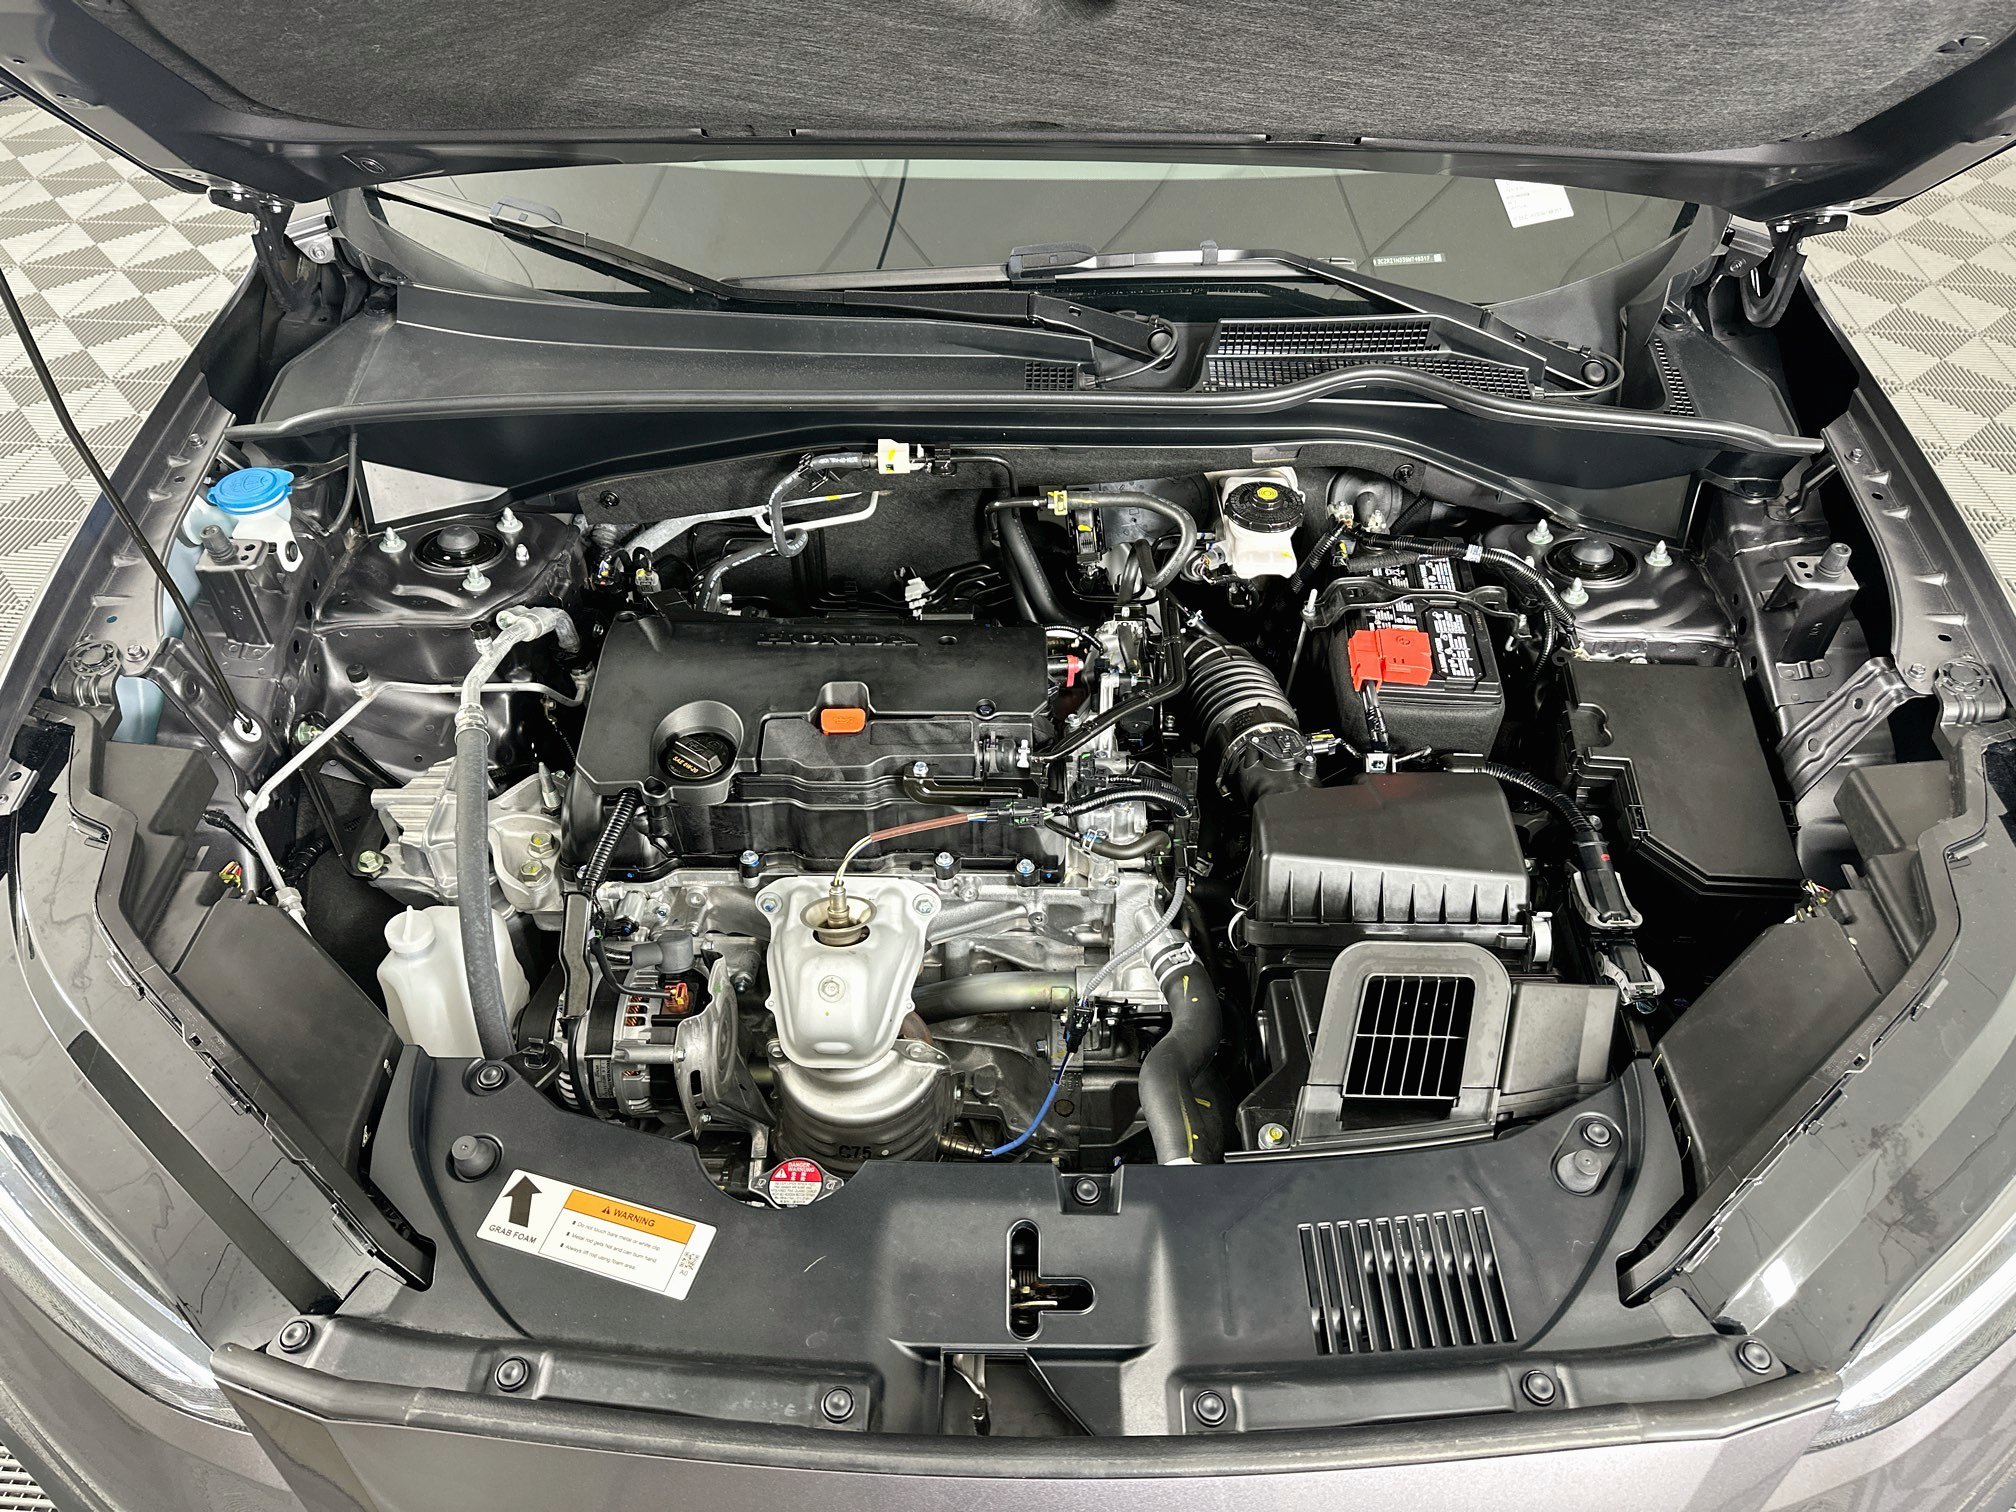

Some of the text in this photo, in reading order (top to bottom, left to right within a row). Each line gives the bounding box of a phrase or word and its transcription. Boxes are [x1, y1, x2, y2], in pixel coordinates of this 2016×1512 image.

[756, 633, 920, 647] HONDA
[672, 755, 685, 766] SAE
[838, 1145, 872, 1159] C75
[613, 1208, 656, 1228] WARNING
[576, 1221, 585, 1229] Do
[488, 1224, 537, 1245] GRAB FOAM
[571, 1232, 585, 1241] Metal
[565, 1244, 582, 1254] Always
